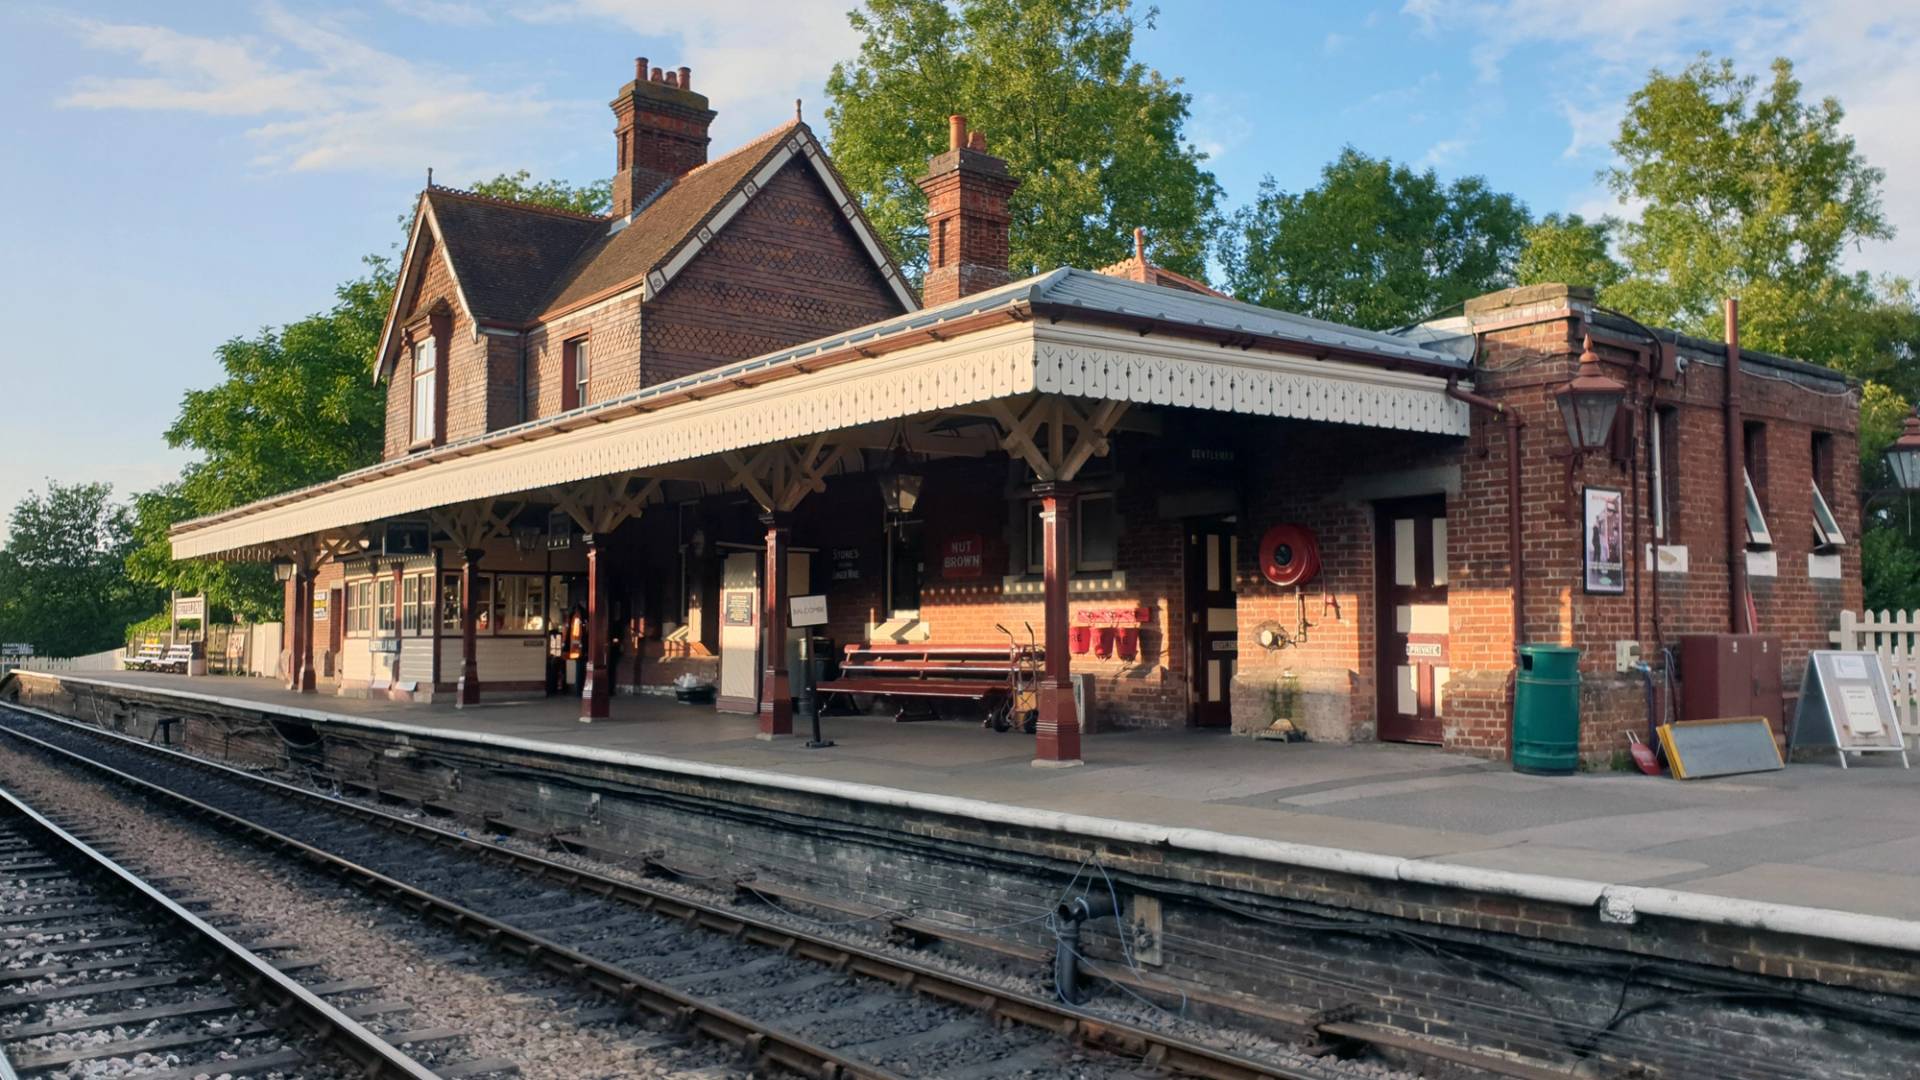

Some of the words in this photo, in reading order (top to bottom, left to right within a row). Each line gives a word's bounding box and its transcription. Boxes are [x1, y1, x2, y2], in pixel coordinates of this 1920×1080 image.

[403, 532, 413, 549] 1
[951, 540, 972, 553] NUT
[944, 554, 981, 568] BROWN
